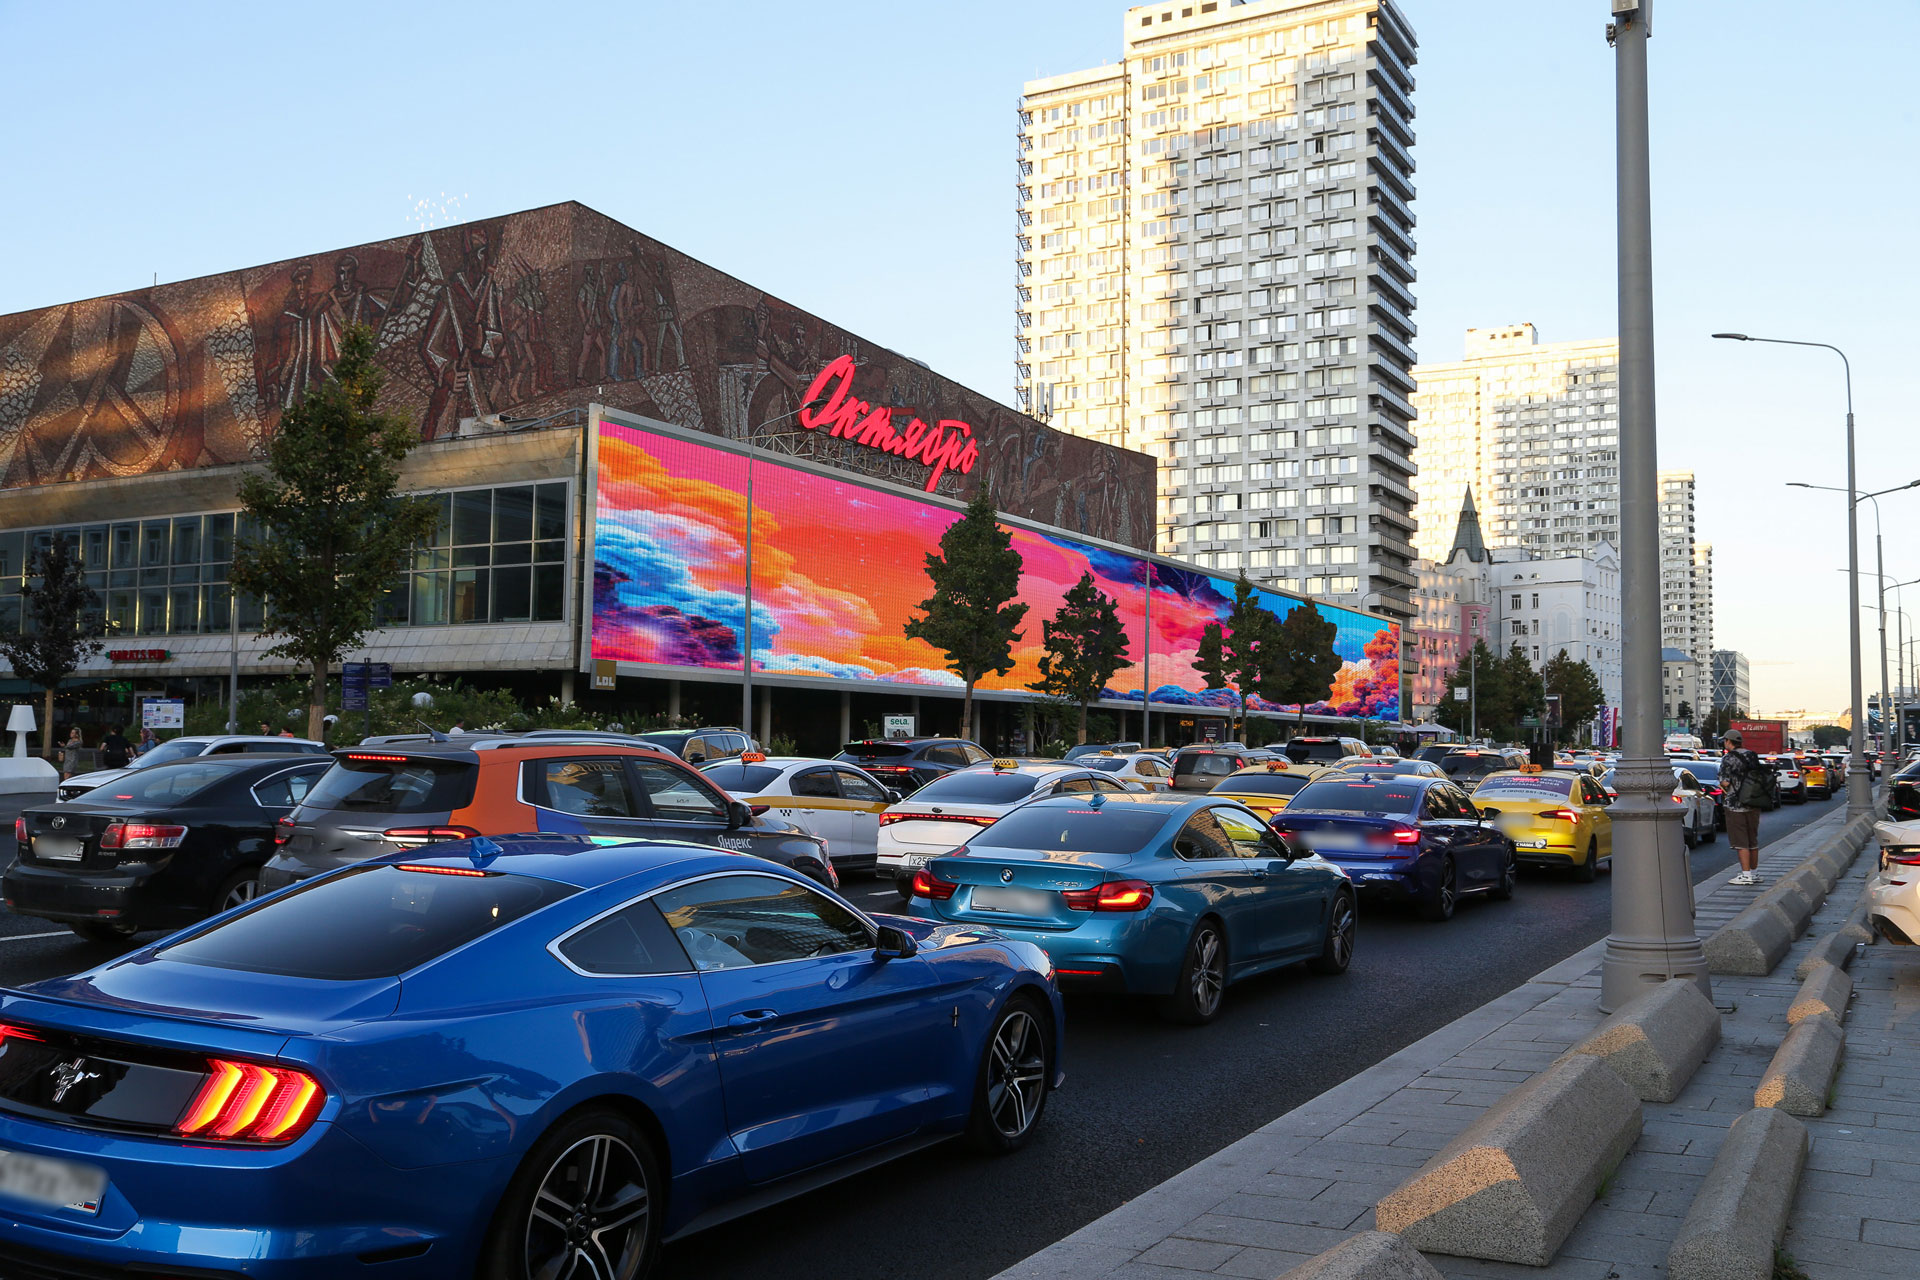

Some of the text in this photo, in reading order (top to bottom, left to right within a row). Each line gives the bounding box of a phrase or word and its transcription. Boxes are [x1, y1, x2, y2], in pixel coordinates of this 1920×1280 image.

[799, 354, 979, 493] Октябрь
[148, 649, 166, 660] PUB
[596, 676, 614, 687] LOL
[717, 834, 753, 850] Яндекс
